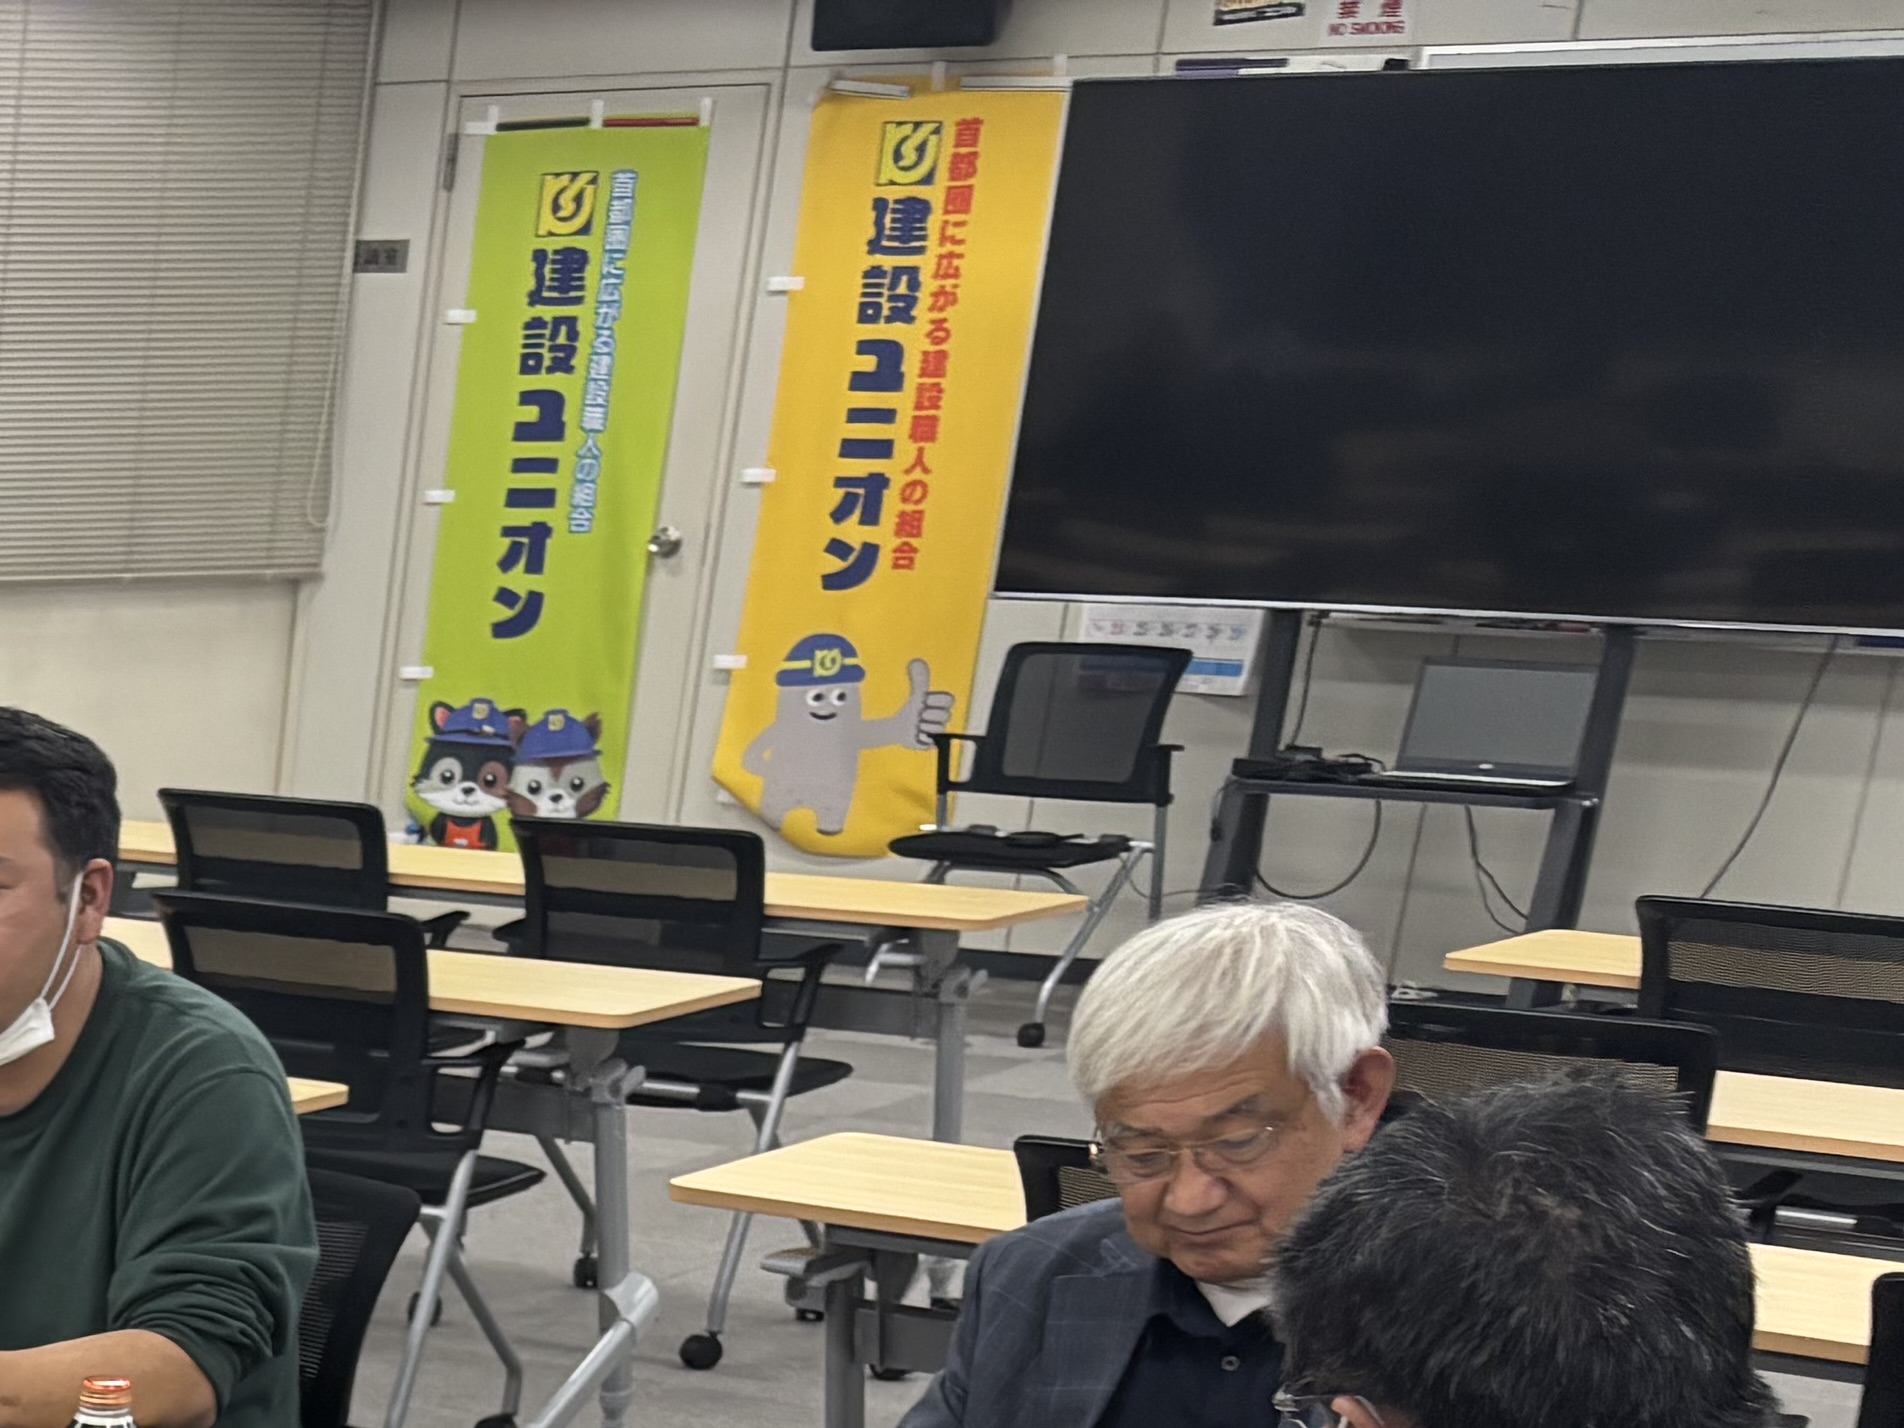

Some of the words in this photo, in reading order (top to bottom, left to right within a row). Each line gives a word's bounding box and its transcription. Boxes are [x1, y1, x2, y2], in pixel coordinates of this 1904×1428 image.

[490, 246, 590, 640] 建設ユニオン
[821, 196, 934, 592] 建設ユニオン
[890, 116, 984, 570] 首都圏に広がる建設職人の組合
